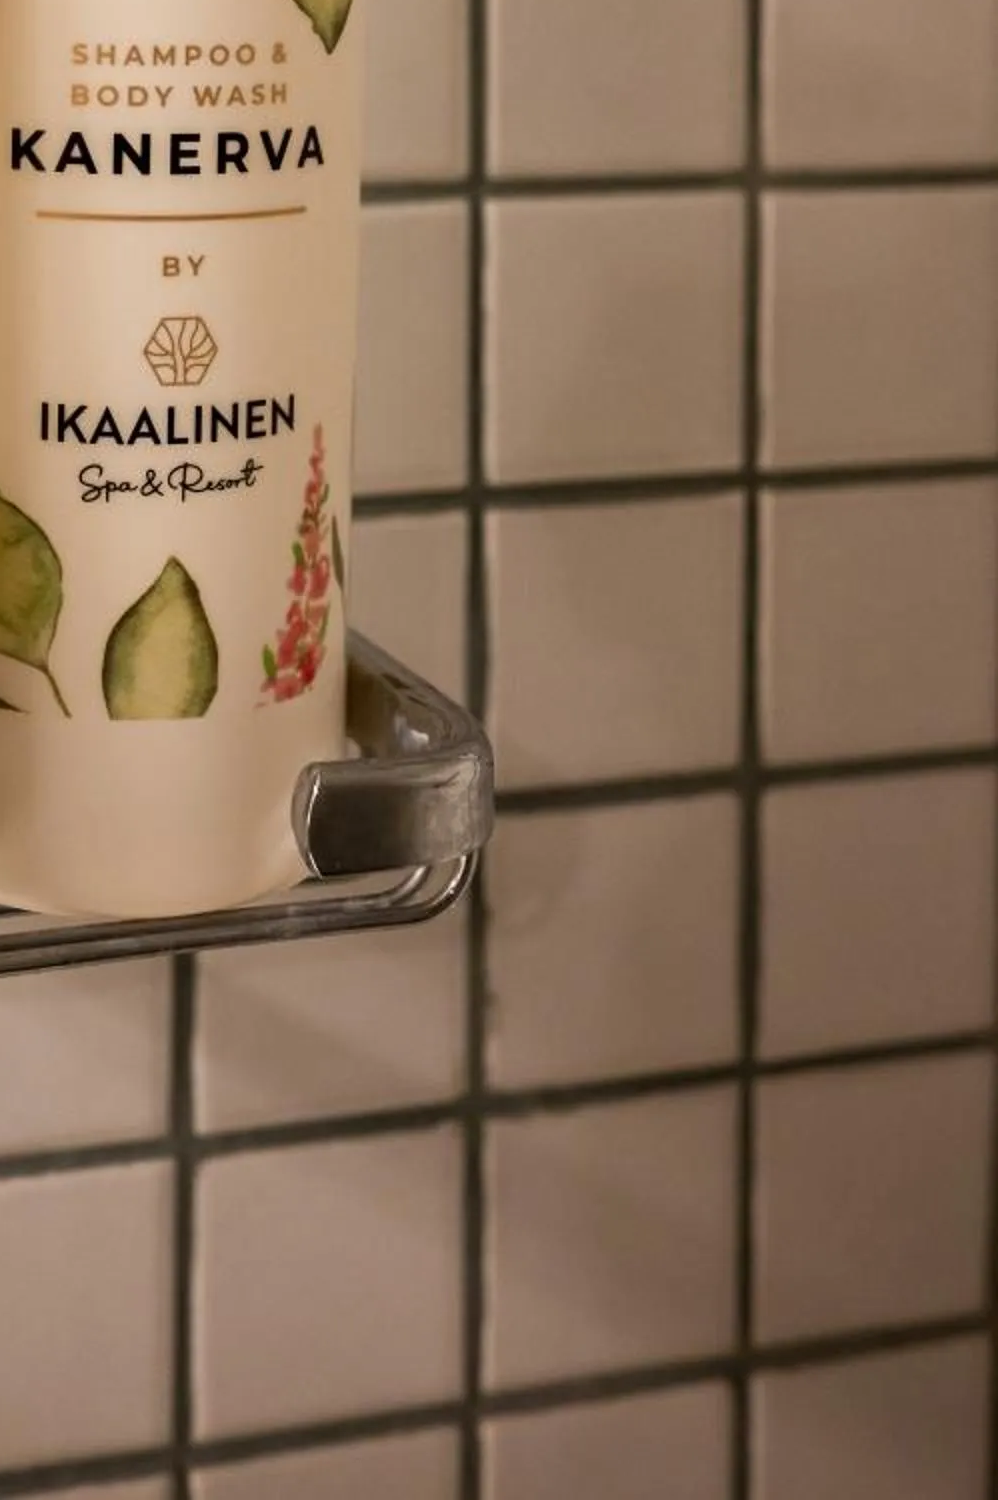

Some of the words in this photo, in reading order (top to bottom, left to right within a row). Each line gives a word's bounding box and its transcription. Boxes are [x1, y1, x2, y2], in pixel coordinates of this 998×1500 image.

[70, 43, 257, 67] SHAMPOO
[271, 42, 288, 65] &
[70, 84, 175, 108] BODY
[194, 82, 288, 107] WASH
[10, 124, 325, 175] KANERVA
[161, 254, 206, 278] BY
[40, 394, 297, 446] IKAALINEN
[78, 463, 137, 503] Spa
[140, 469, 165, 497] &
[167, 458, 264, 503] Resort
